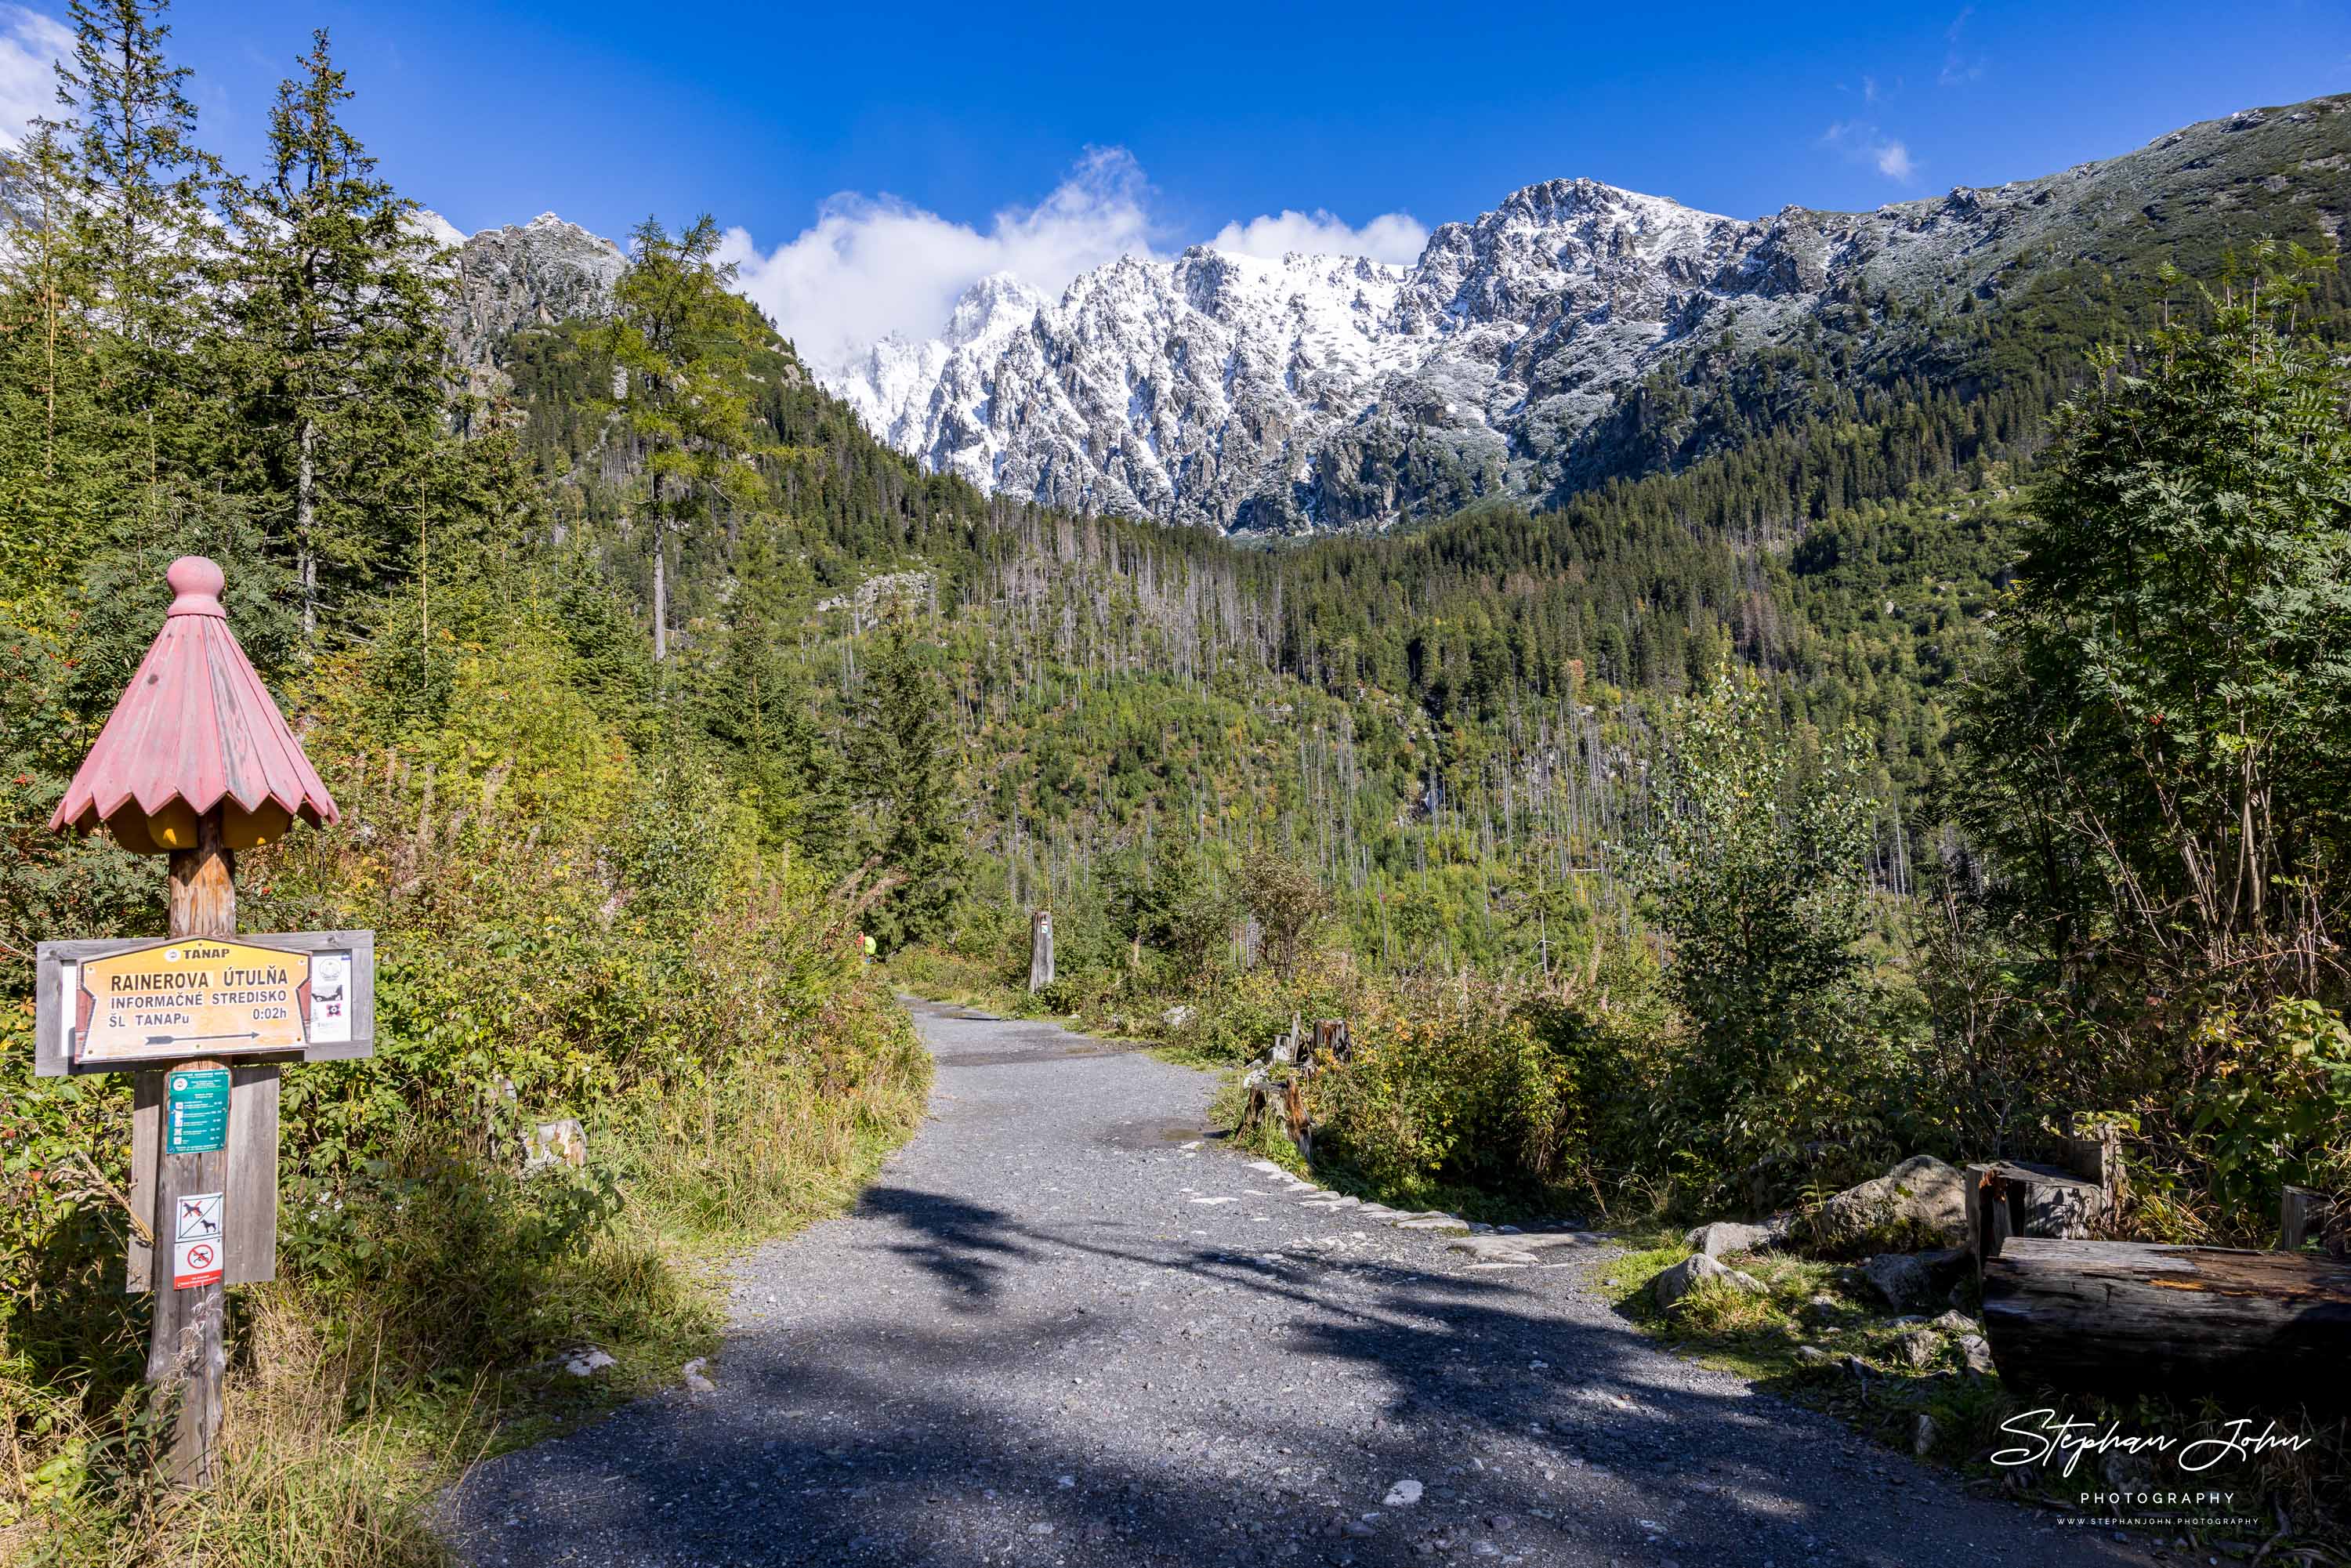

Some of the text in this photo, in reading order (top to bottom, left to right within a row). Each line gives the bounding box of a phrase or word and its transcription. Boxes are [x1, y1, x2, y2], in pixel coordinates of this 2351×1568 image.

[183, 948, 230, 959] TANAP
[111, 965, 288, 991] RAINEROVA ÚTULŇA
[111, 990, 287, 1010] INFORMAČNÉ STREDISKO
[109, 1009, 287, 1028] ŠL TANAPu 0:02h
